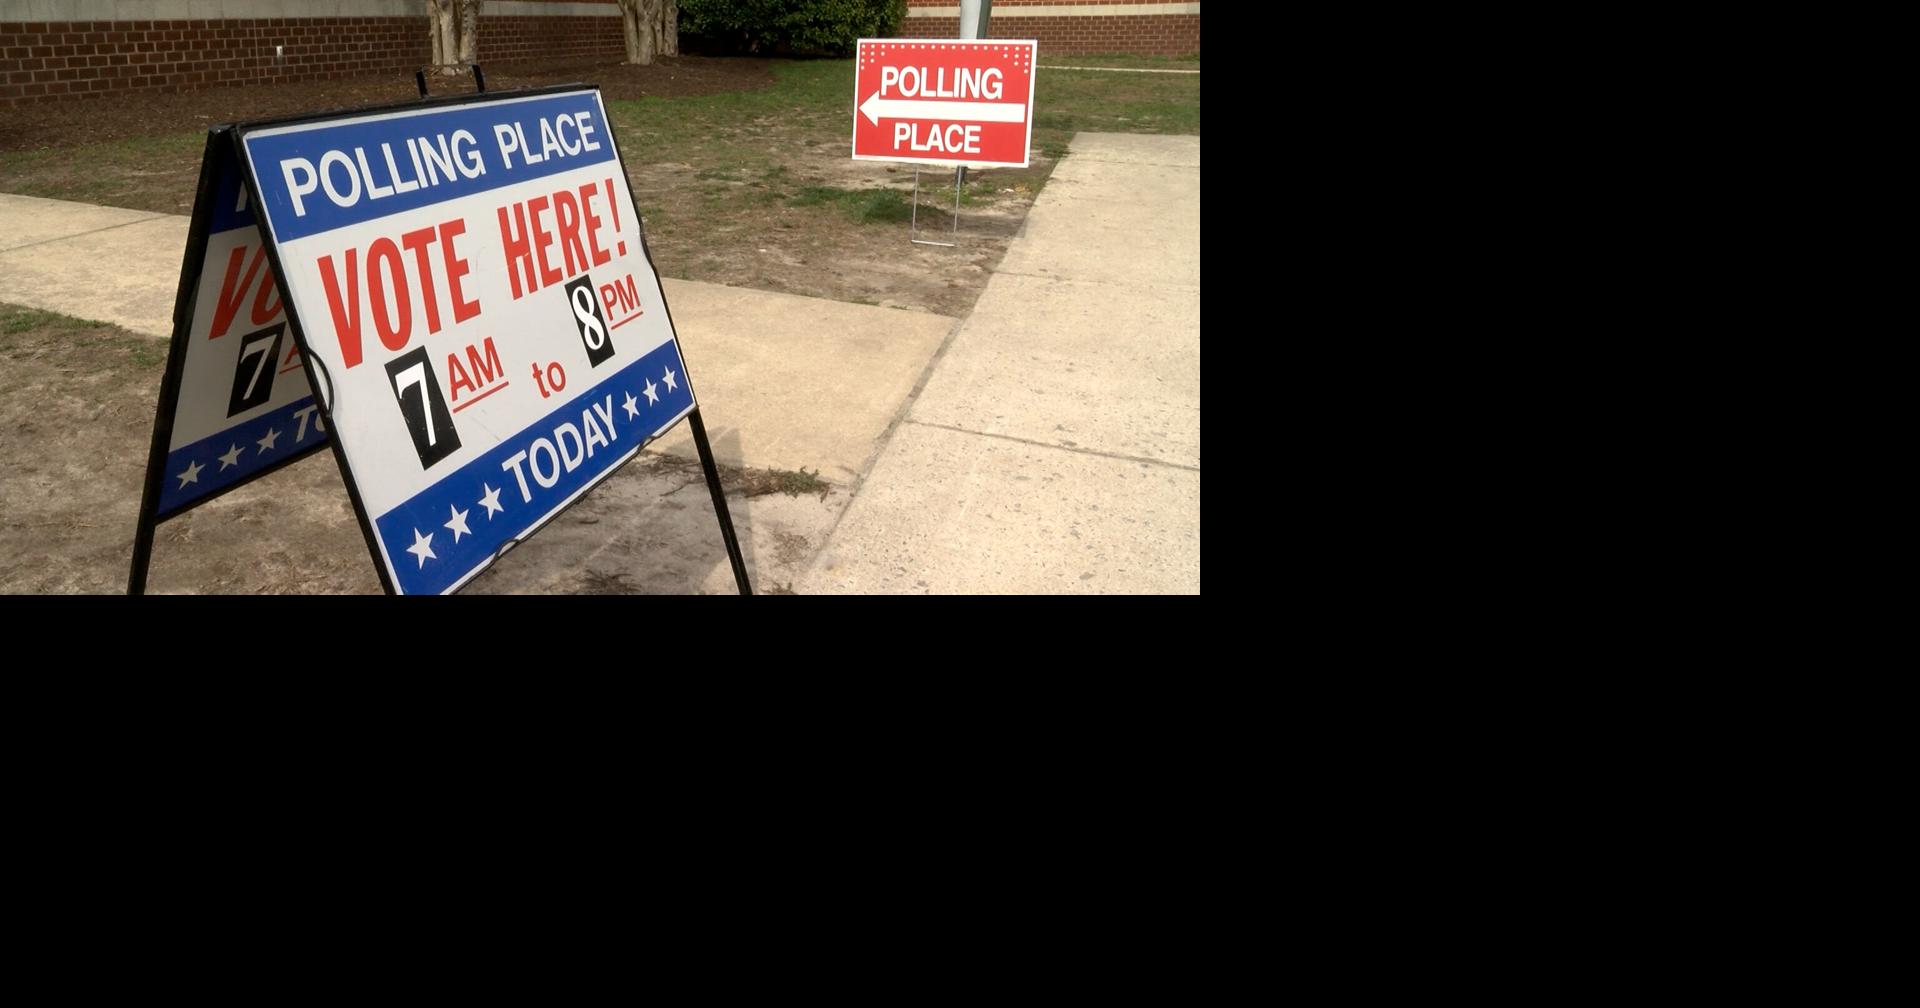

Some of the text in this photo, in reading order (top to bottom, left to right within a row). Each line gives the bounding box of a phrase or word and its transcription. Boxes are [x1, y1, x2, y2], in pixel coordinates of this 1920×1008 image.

[880, 65, 1003, 99] POLLING
[280, 129, 486, 217] POLLING
[493, 111, 601, 170] PLACE
[894, 122, 982, 154] PLACE
[317, 178, 627, 370] VOTE HERE!
[240, 333, 278, 400] 7
[395, 361, 437, 447] 7
[447, 336, 504, 402] AM
[532, 361, 567, 399] to
[571, 285, 605, 351] 8
[600, 274, 641, 321] PM
[502, 394, 618, 504] TODAY
